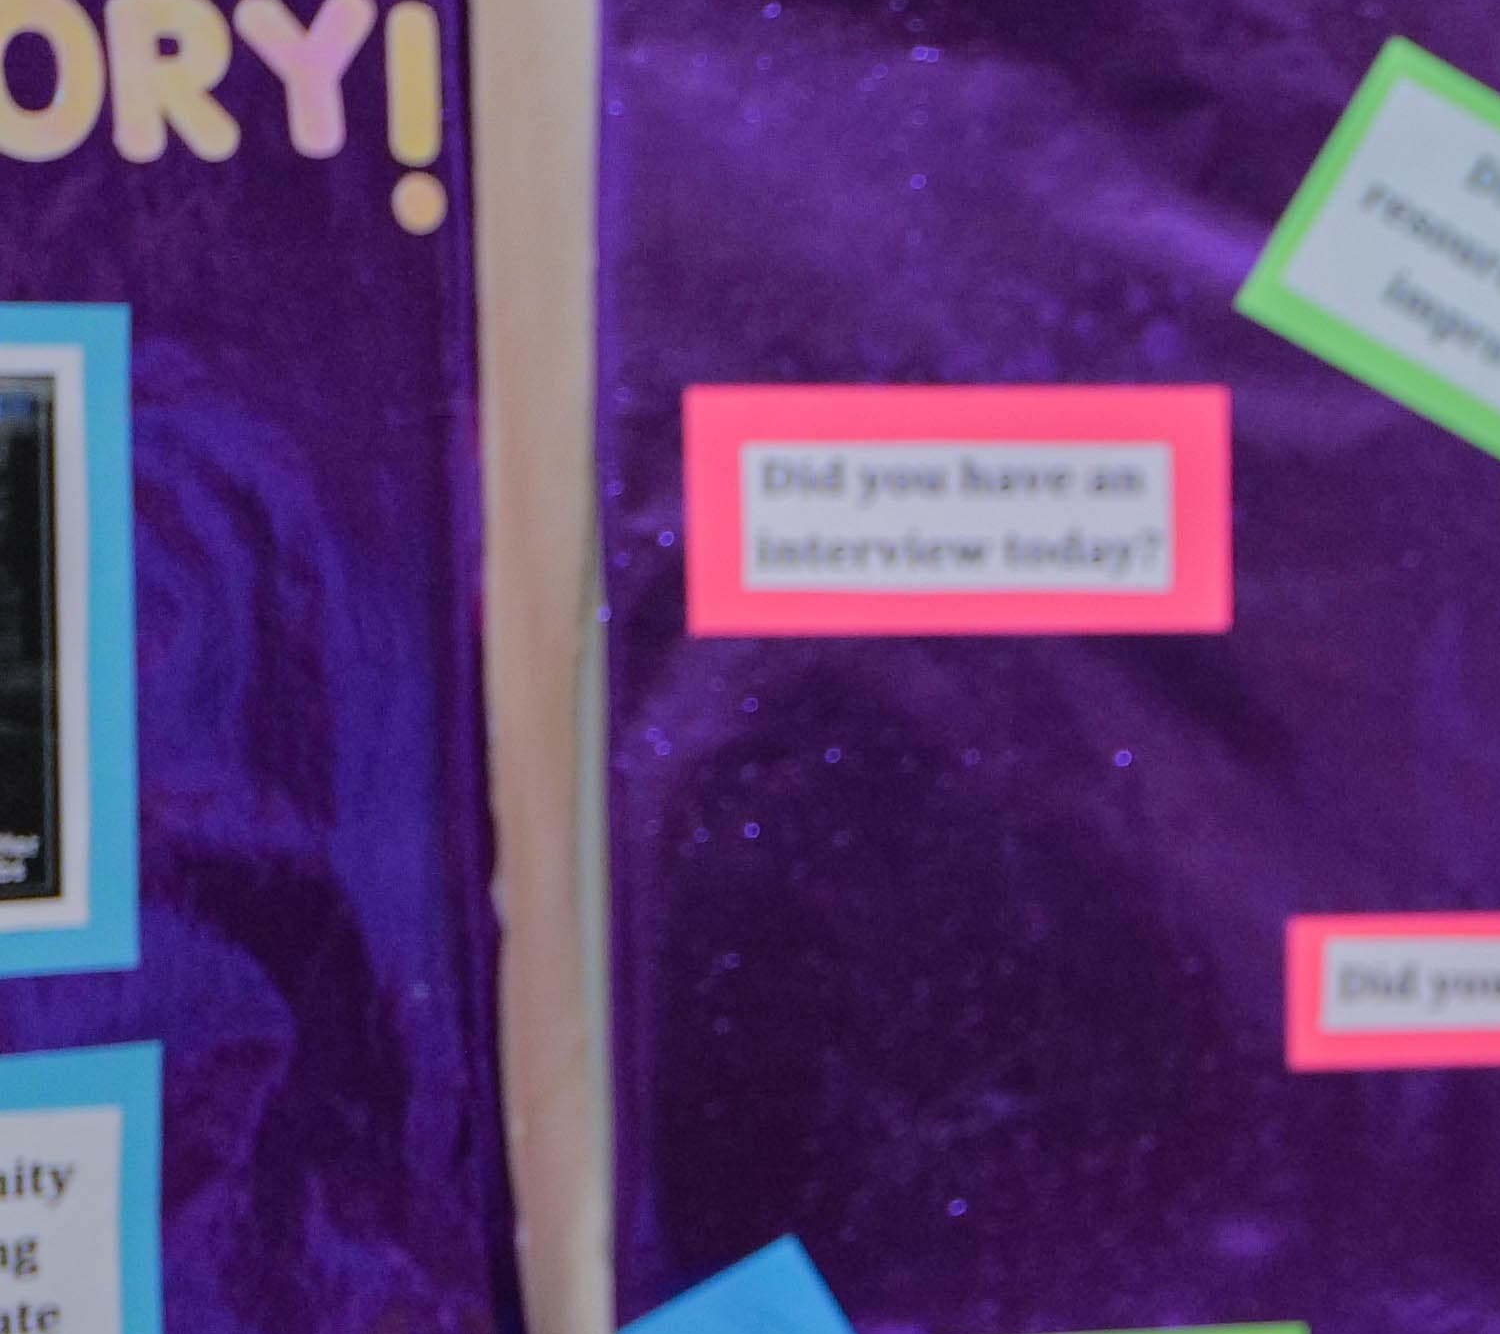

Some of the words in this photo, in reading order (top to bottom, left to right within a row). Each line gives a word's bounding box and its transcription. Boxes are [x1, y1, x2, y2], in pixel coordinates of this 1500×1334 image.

[761, 456, 843, 493] Did
[856, 463, 946, 507] you
[958, 456, 1072, 493] have
[1084, 463, 1145, 493] an
[756, 530, 986, 566] interview
